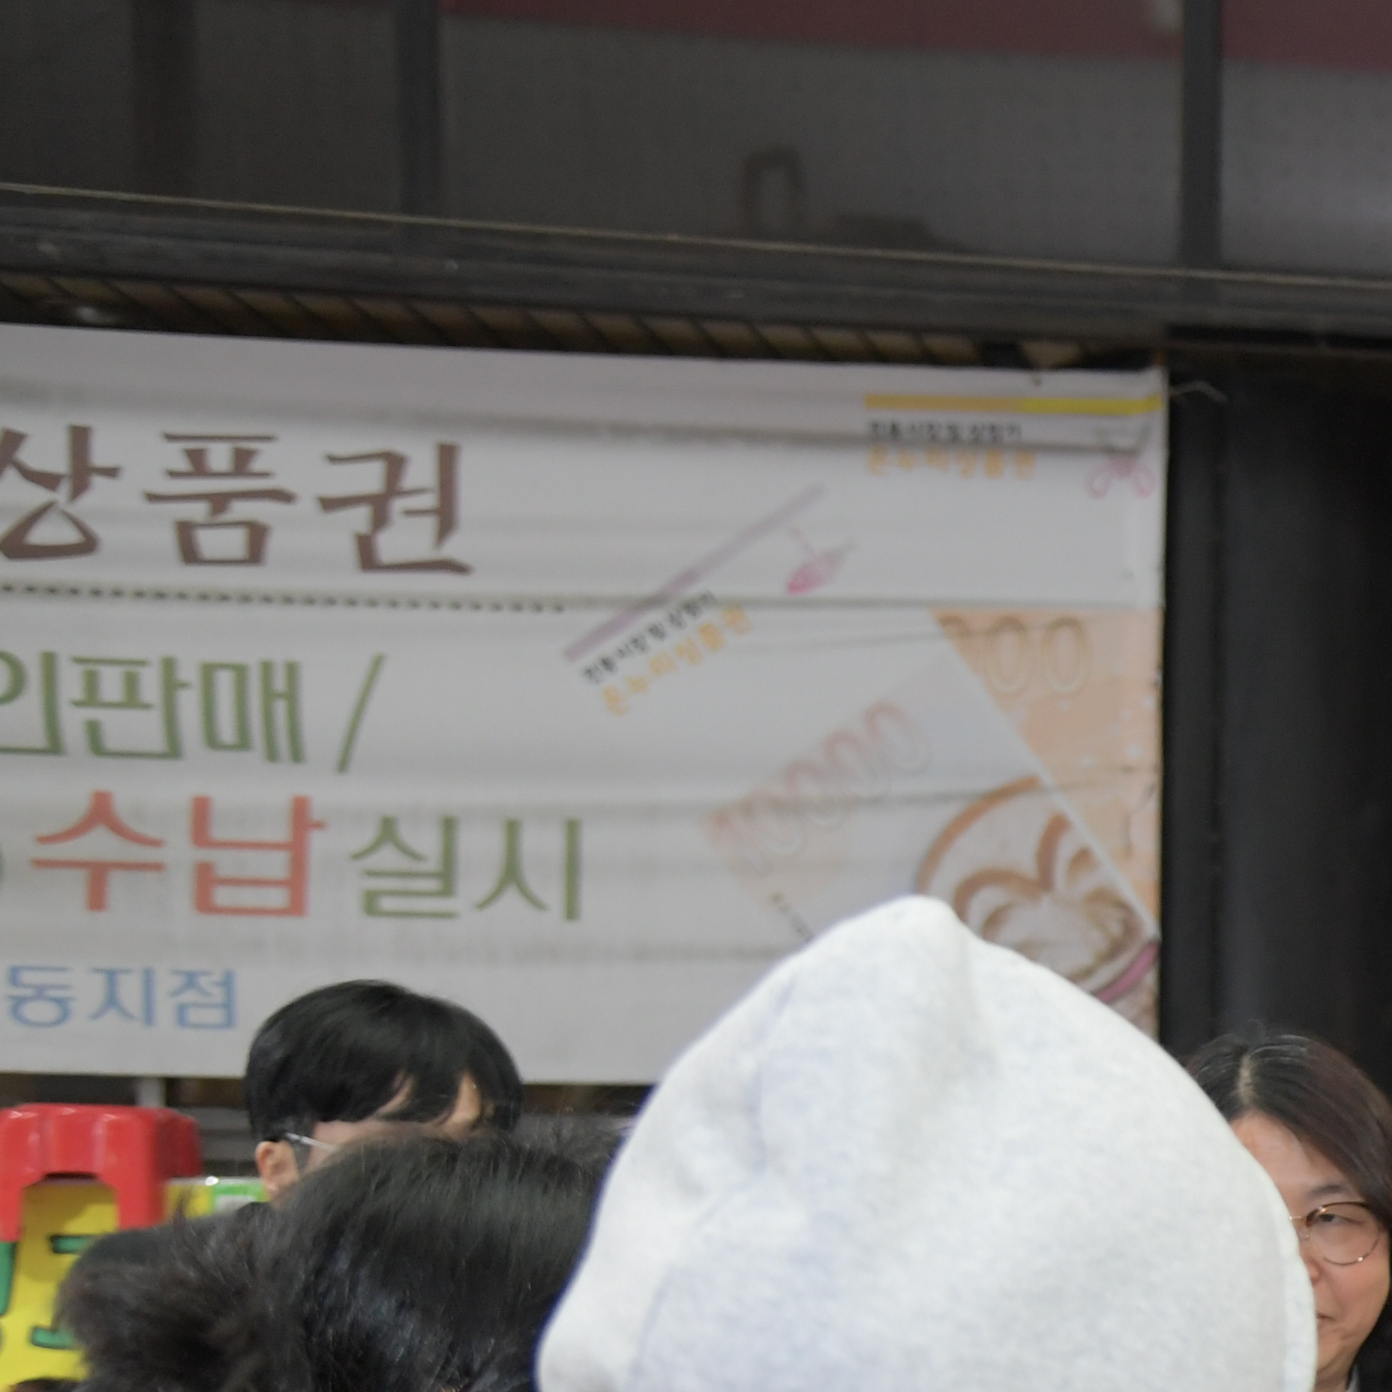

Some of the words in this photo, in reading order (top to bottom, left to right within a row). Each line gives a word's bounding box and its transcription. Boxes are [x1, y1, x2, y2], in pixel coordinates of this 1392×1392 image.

[0, 424, 473, 575] 상품권
[30, 789, 324, 918] 수납
[350, 813, 584, 922] 실시
[4, 963, 238, 1032] 동지점
